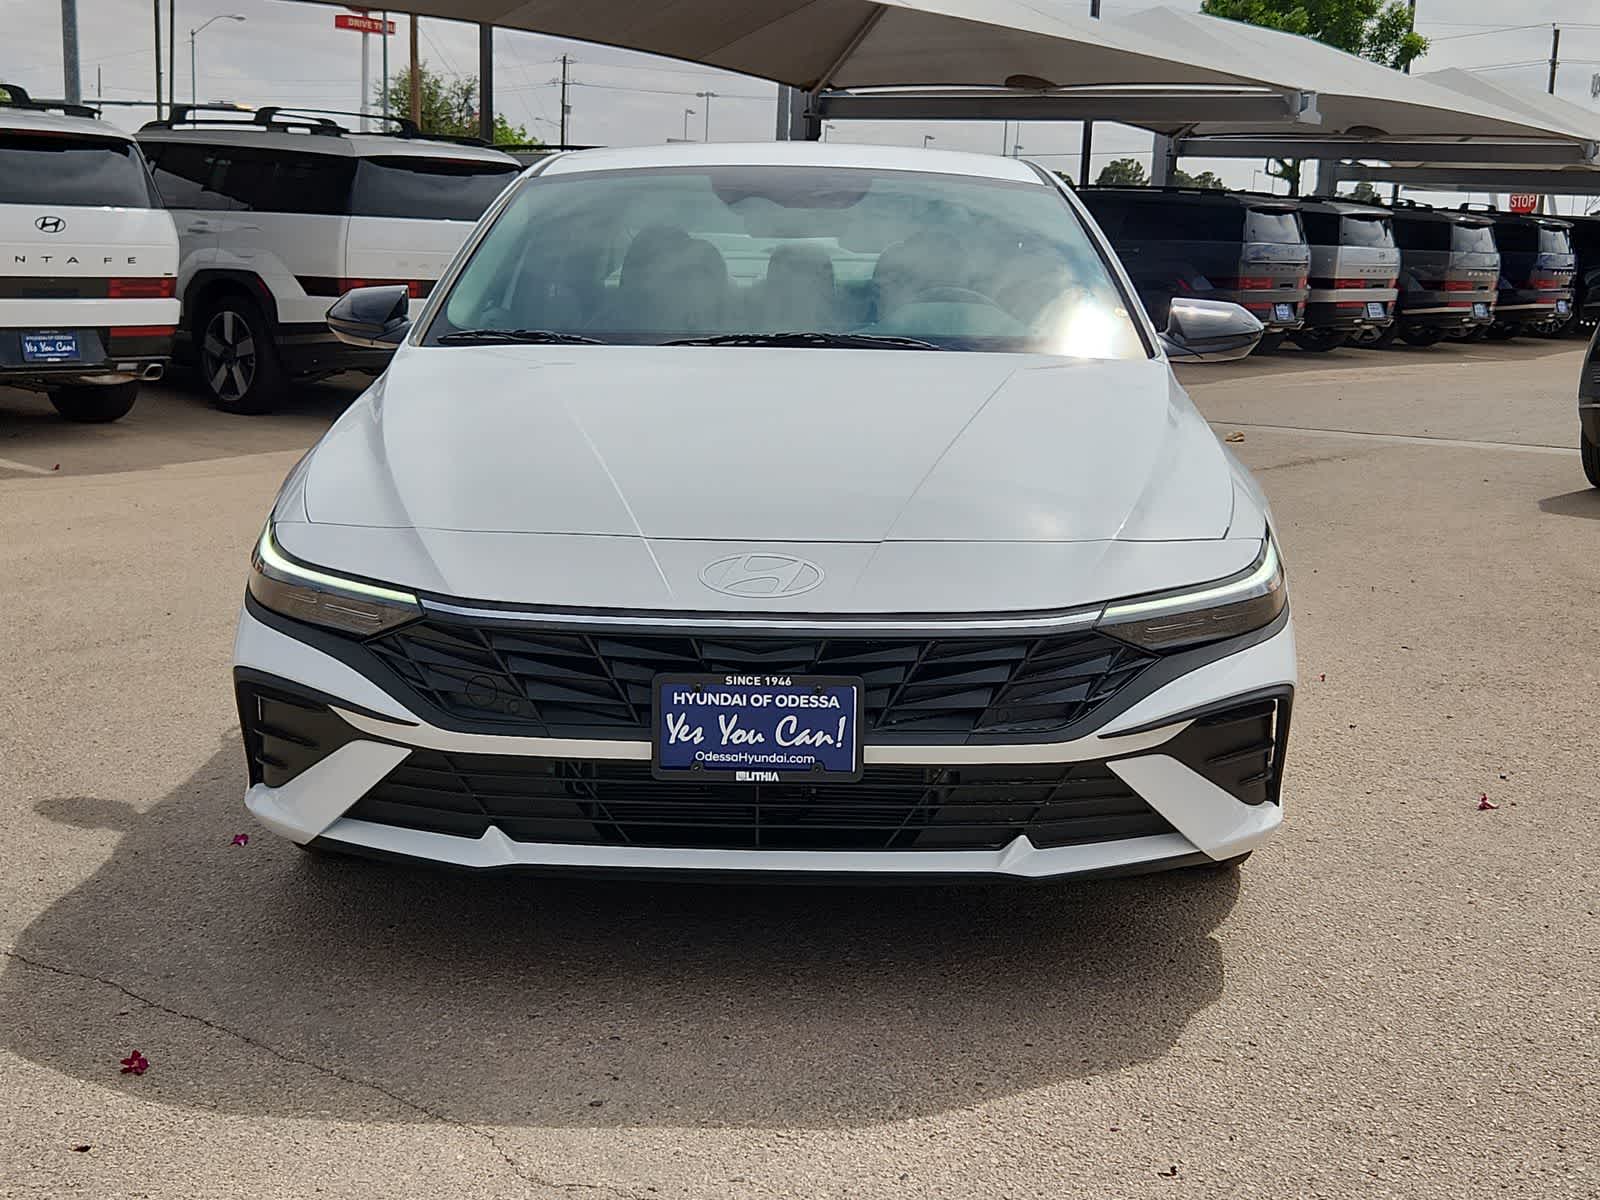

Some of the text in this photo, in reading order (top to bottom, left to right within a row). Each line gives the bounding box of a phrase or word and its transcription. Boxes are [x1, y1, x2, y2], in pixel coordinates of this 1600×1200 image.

[348, 18, 372, 30] DRIVE
[1511, 195, 1536, 208] STOP
[103, 256, 137, 265] FE
[25, 341, 37, 353] Yes
[39, 341, 55, 353] You
[725, 675, 792, 687] SINCE 1946
[673, 692, 840, 709] HYUNDAI OF ODESSA
[665, 712, 847, 748] Yes You Can!
[695, 750, 816, 766] OdessaHyundai.com
[746, 771, 780, 783] LITHIA
